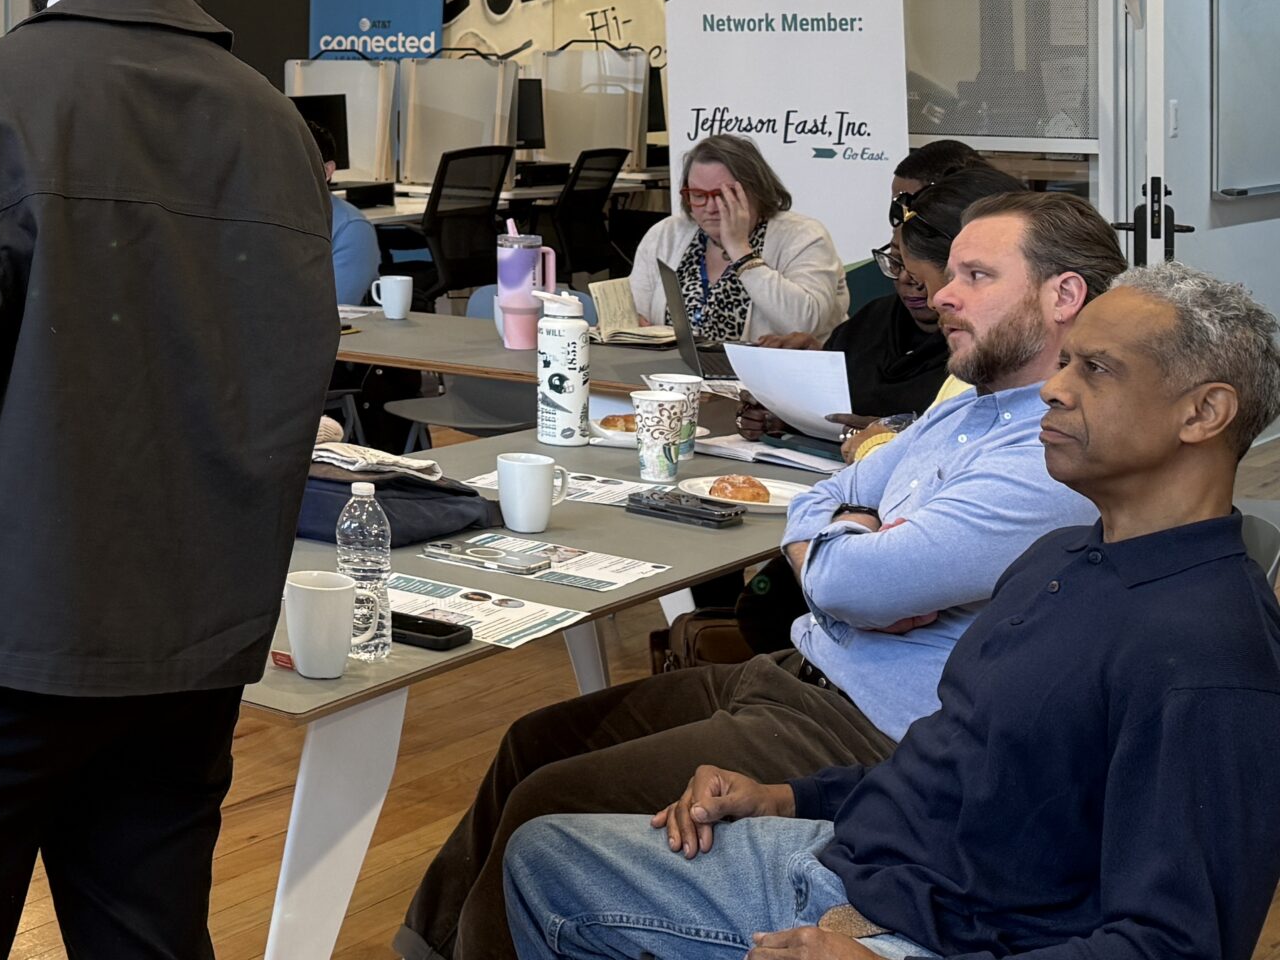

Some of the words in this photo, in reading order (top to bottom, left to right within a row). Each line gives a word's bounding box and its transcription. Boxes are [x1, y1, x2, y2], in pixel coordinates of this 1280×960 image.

[702, 12, 775, 32] Network
[781, 12, 863, 32] Member:
[320, 31, 435, 53] connected
[687, 107, 778, 141] Jefferson
[782, 110, 832, 144] East,
[832, 111, 871, 145] Inc.
[842, 147, 860, 160] Go
[567, 341, 577, 371] 1855
